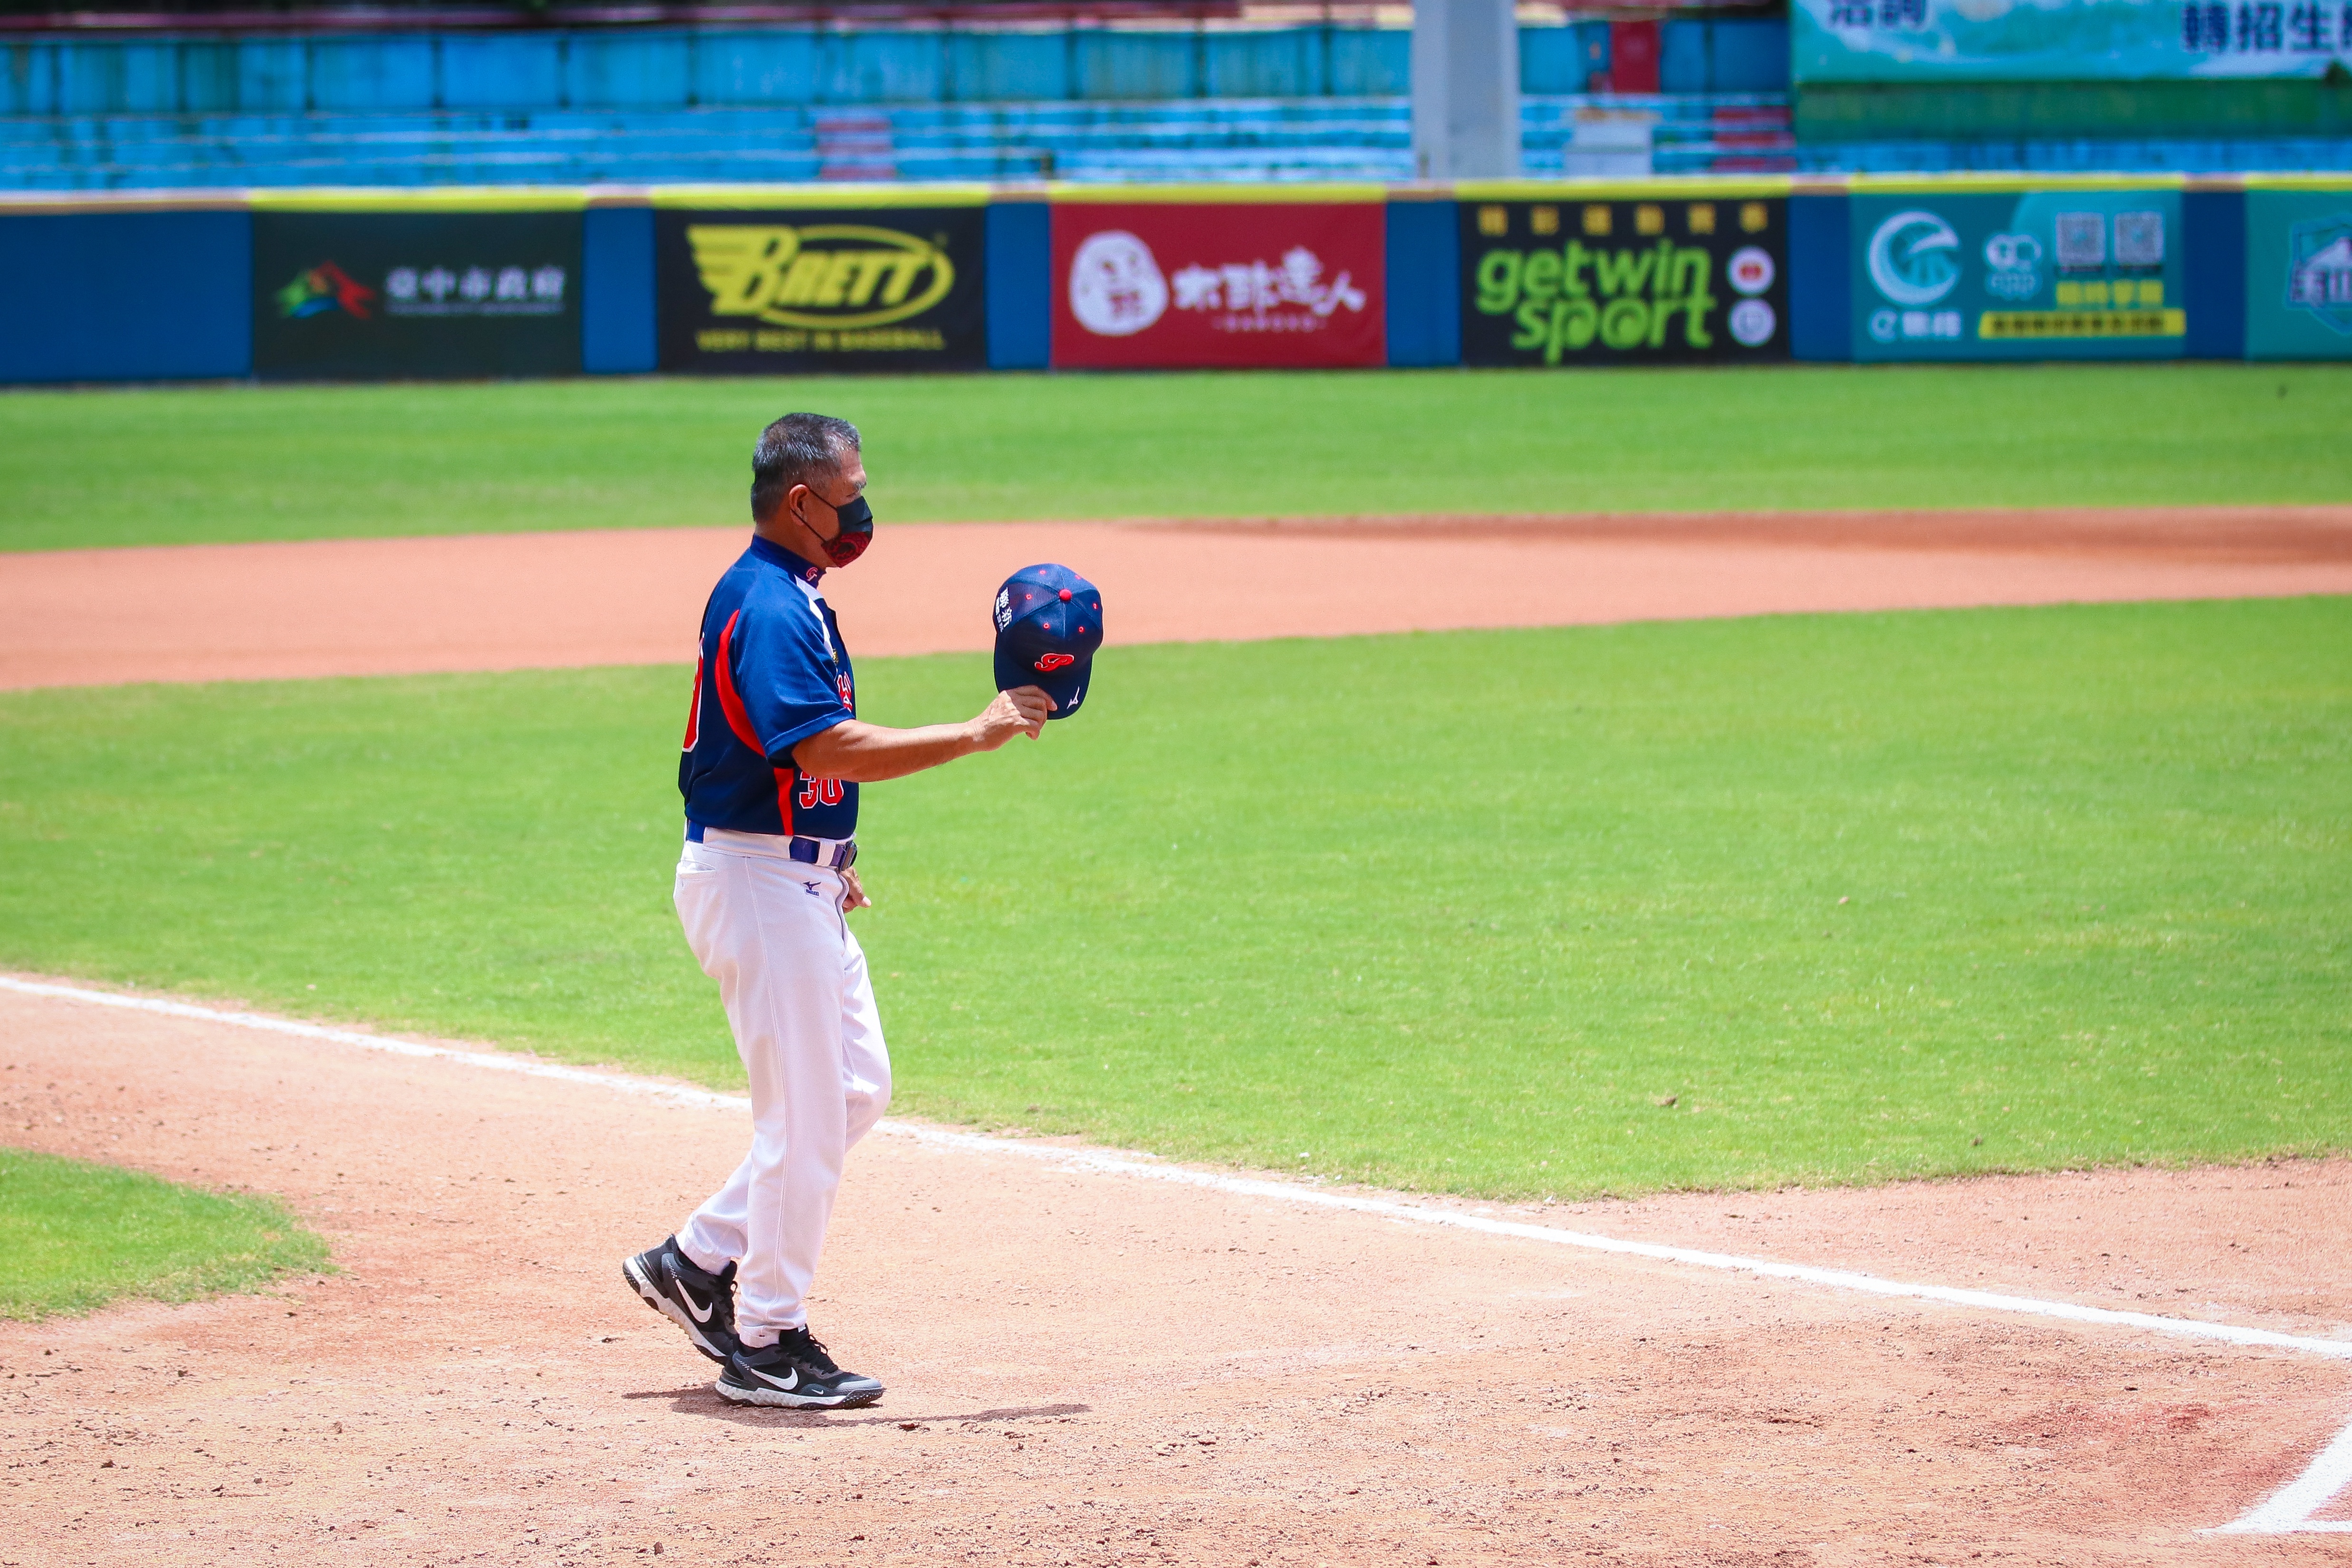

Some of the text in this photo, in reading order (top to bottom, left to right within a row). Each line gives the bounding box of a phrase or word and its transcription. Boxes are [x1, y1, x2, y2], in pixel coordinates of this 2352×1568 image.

[2184, 2, 2352, 54] 轉招生
[686, 223, 932, 317] BRETT
[1475, 239, 1714, 315] getwin
[1510, 289, 1718, 367] sport
[799, 770, 844, 809] 30
